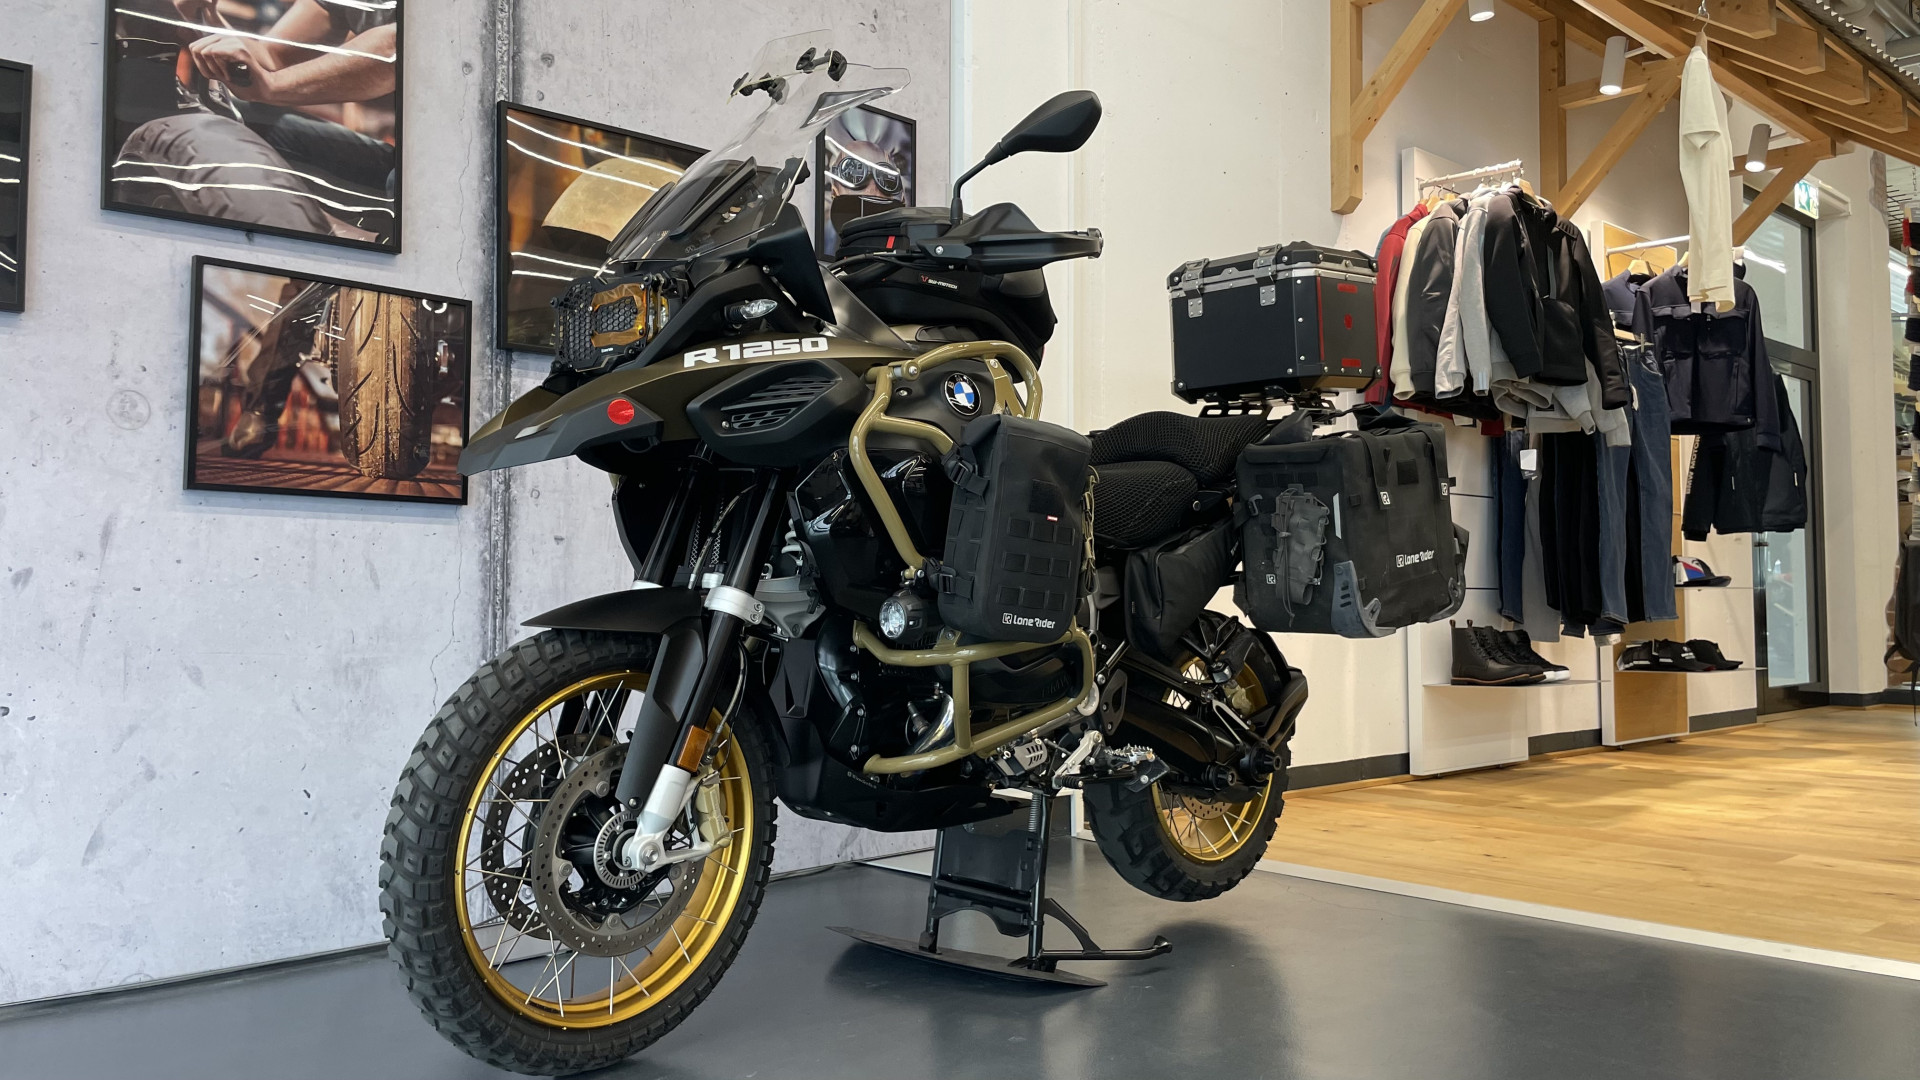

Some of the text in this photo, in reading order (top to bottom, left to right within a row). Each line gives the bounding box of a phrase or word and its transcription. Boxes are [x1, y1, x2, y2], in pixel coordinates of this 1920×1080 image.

[683, 337, 829, 368] R 1250
[1013, 615, 1033, 626] Lone
[1034, 618, 1055, 628] Rider
